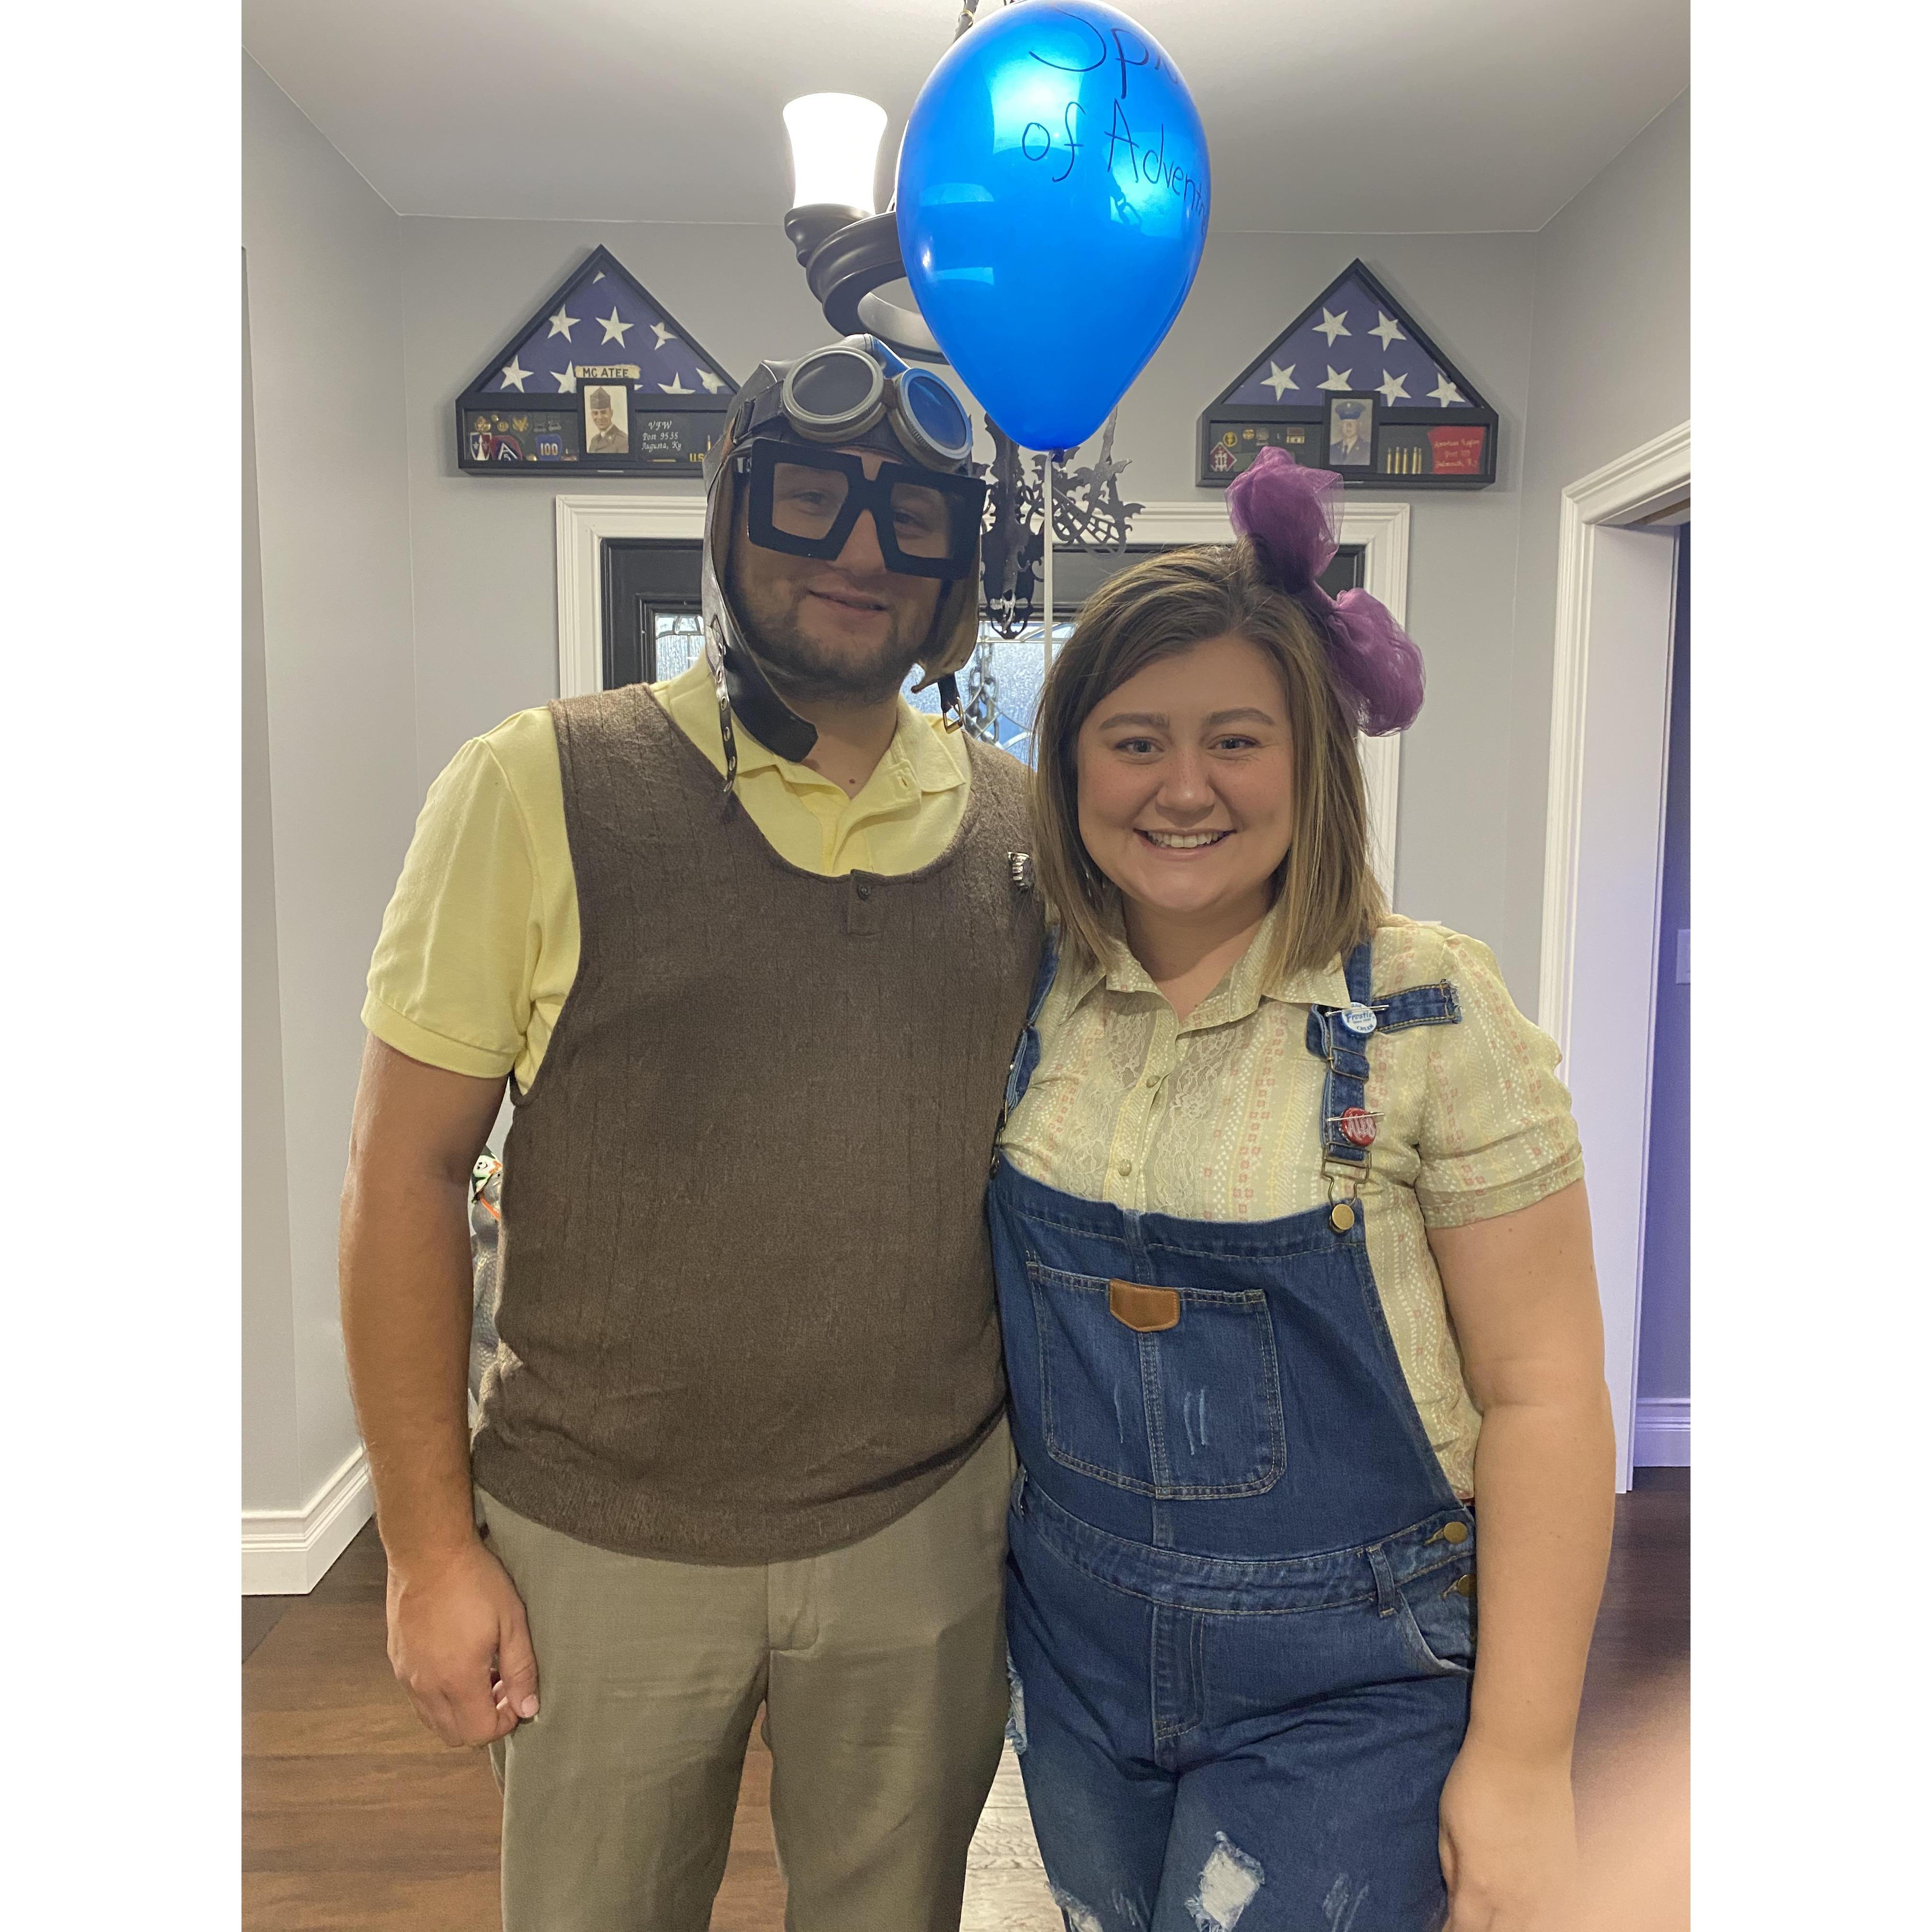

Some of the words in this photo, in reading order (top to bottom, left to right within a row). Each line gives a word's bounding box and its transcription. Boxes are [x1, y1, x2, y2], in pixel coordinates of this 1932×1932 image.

[1022, 101, 1086, 182] of
[582, 367, 598, 378] MC
[600, 367, 629, 378] ATEE
[648, 420, 672, 431] VFW
[642, 432, 656, 441] Post
[660, 432, 678, 440] 9535
[540, 442, 558, 456] 100
[641, 442, 669, 452] Augusta,
